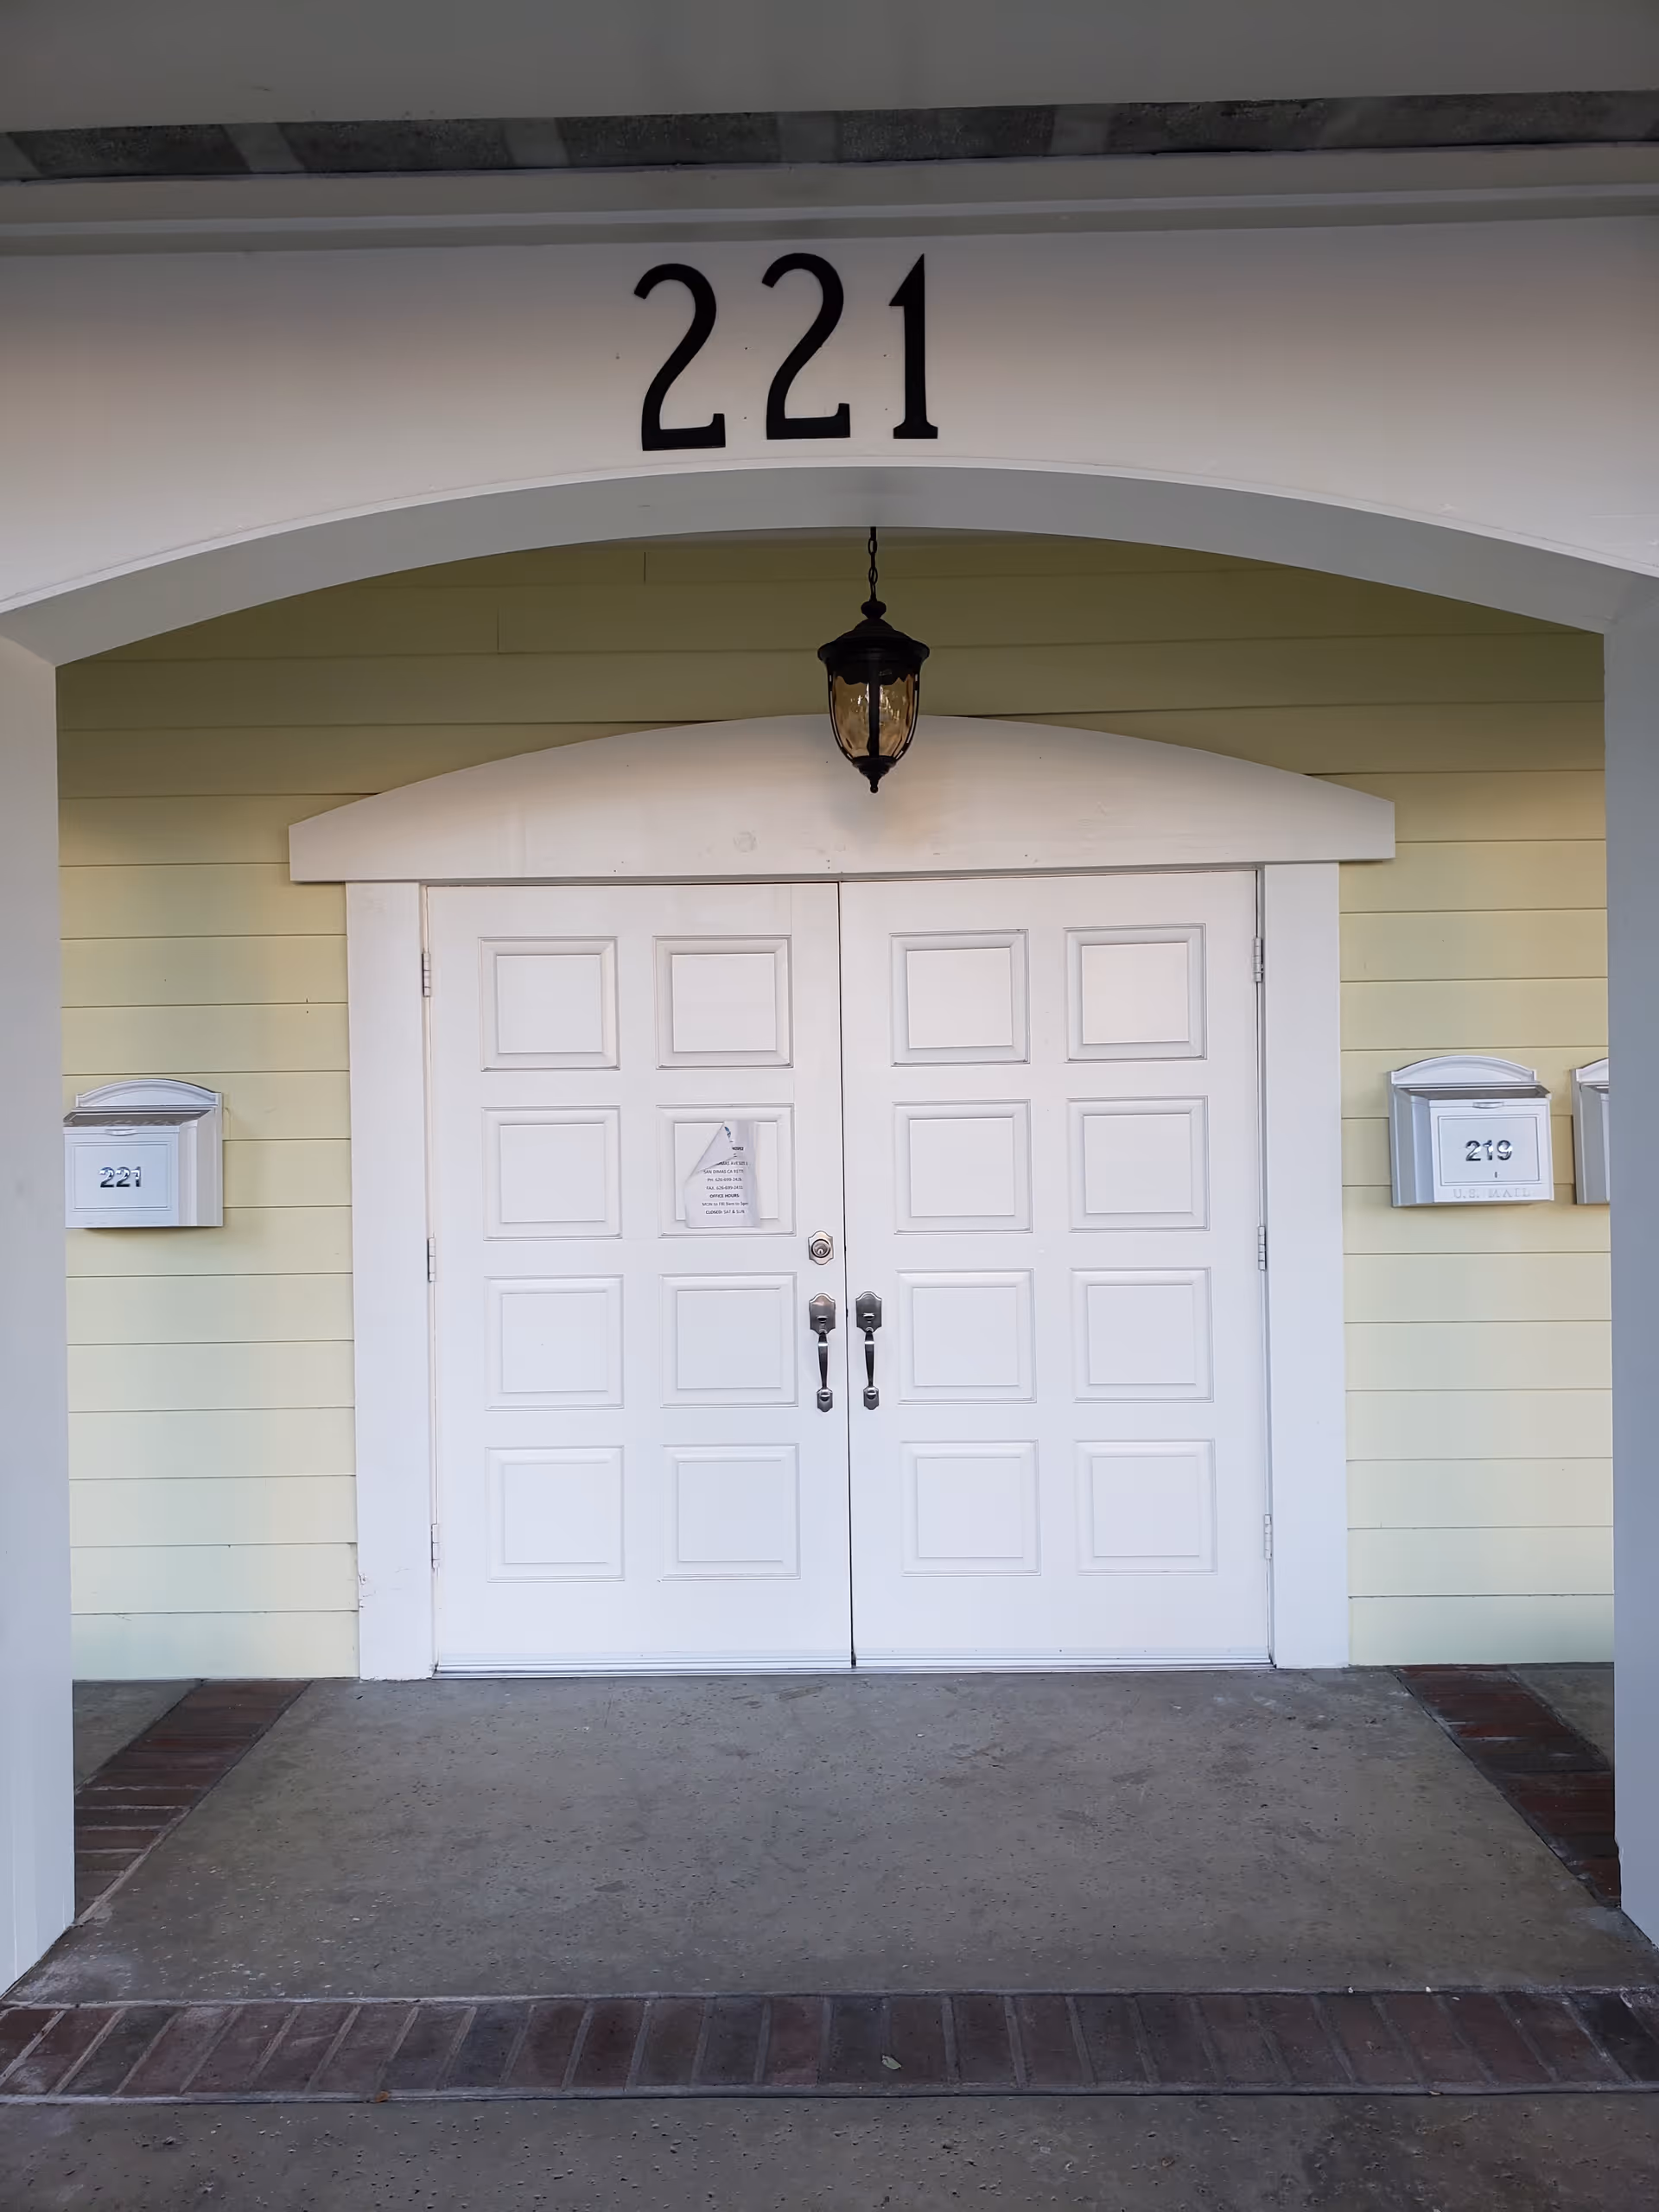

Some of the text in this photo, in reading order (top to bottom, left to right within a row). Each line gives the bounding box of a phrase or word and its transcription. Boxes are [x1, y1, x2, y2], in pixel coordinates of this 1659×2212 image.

[634, 252, 938, 452] 221
[1465, 1139, 1512, 1161] 219
[97, 1166, 142, 1188] 221
[1489, 1187, 1531, 1198] MAIL
